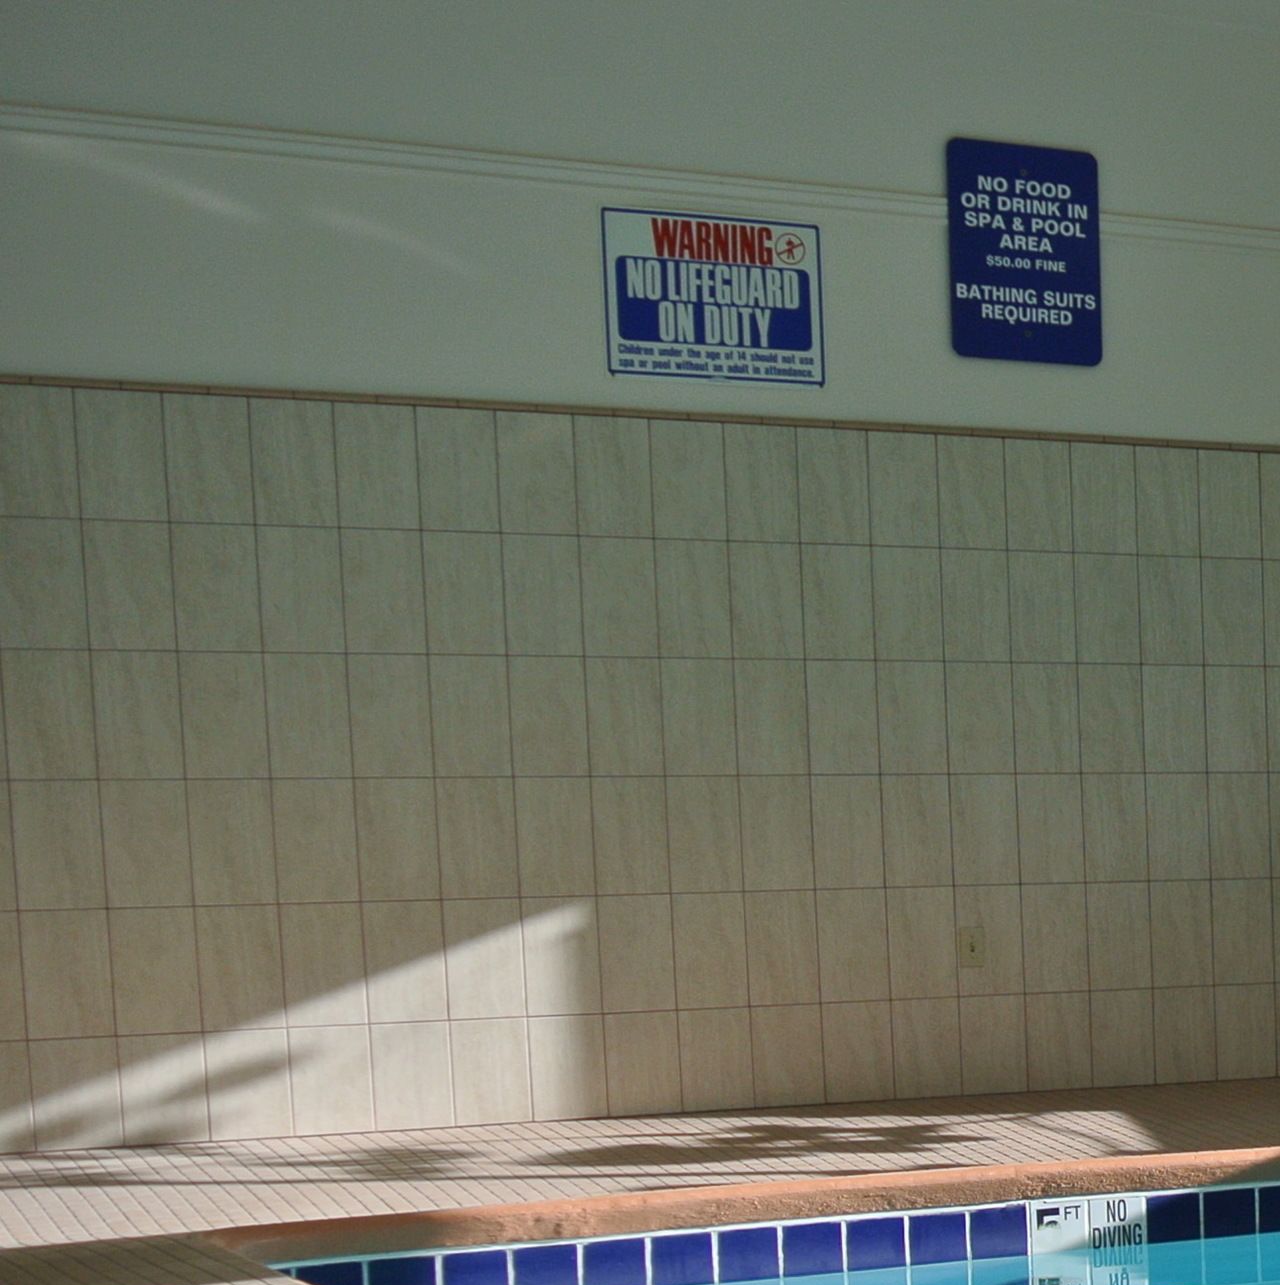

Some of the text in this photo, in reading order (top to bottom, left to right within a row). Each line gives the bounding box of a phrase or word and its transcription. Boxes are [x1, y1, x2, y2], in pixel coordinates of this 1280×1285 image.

[978, 175, 1071, 199] NO FOOD
[961, 192, 1088, 220] OR DRINK IN
[964, 211, 1086, 238] SPA & POOL
[651, 217, 774, 266] WARNING
[1000, 234, 1053, 253] AREA
[986, 255, 1066, 272] $50.00 FINE
[626, 258, 800, 309] NO LIFEGUARD
[956, 282, 1096, 310] BATHING SUITS
[658, 301, 771, 348] ON DUTY
[981, 303, 1072, 326] REQUIRED
[618, 343, 655, 356] Children
[658, 347, 682, 357] under
[687, 349, 701, 358] the
[706, 351, 721, 361] age
[724, 350, 734, 360] of
[751, 352, 778, 363] should
[782, 354, 796, 364] not
[799, 357, 814, 365] use
[619, 359, 635, 369] spa
[639, 360, 648, 368] or
[652, 360, 671, 371] pool
[675, 361, 709, 372] without
[713, 364, 724, 372] an
[728, 363, 750, 374] adult
[752, 364, 761, 374] in
[1064, 1205, 1081, 1220] FT
[1106, 1199, 1127, 1223] NO
[1092, 1223, 1143, 1249] DIVING
